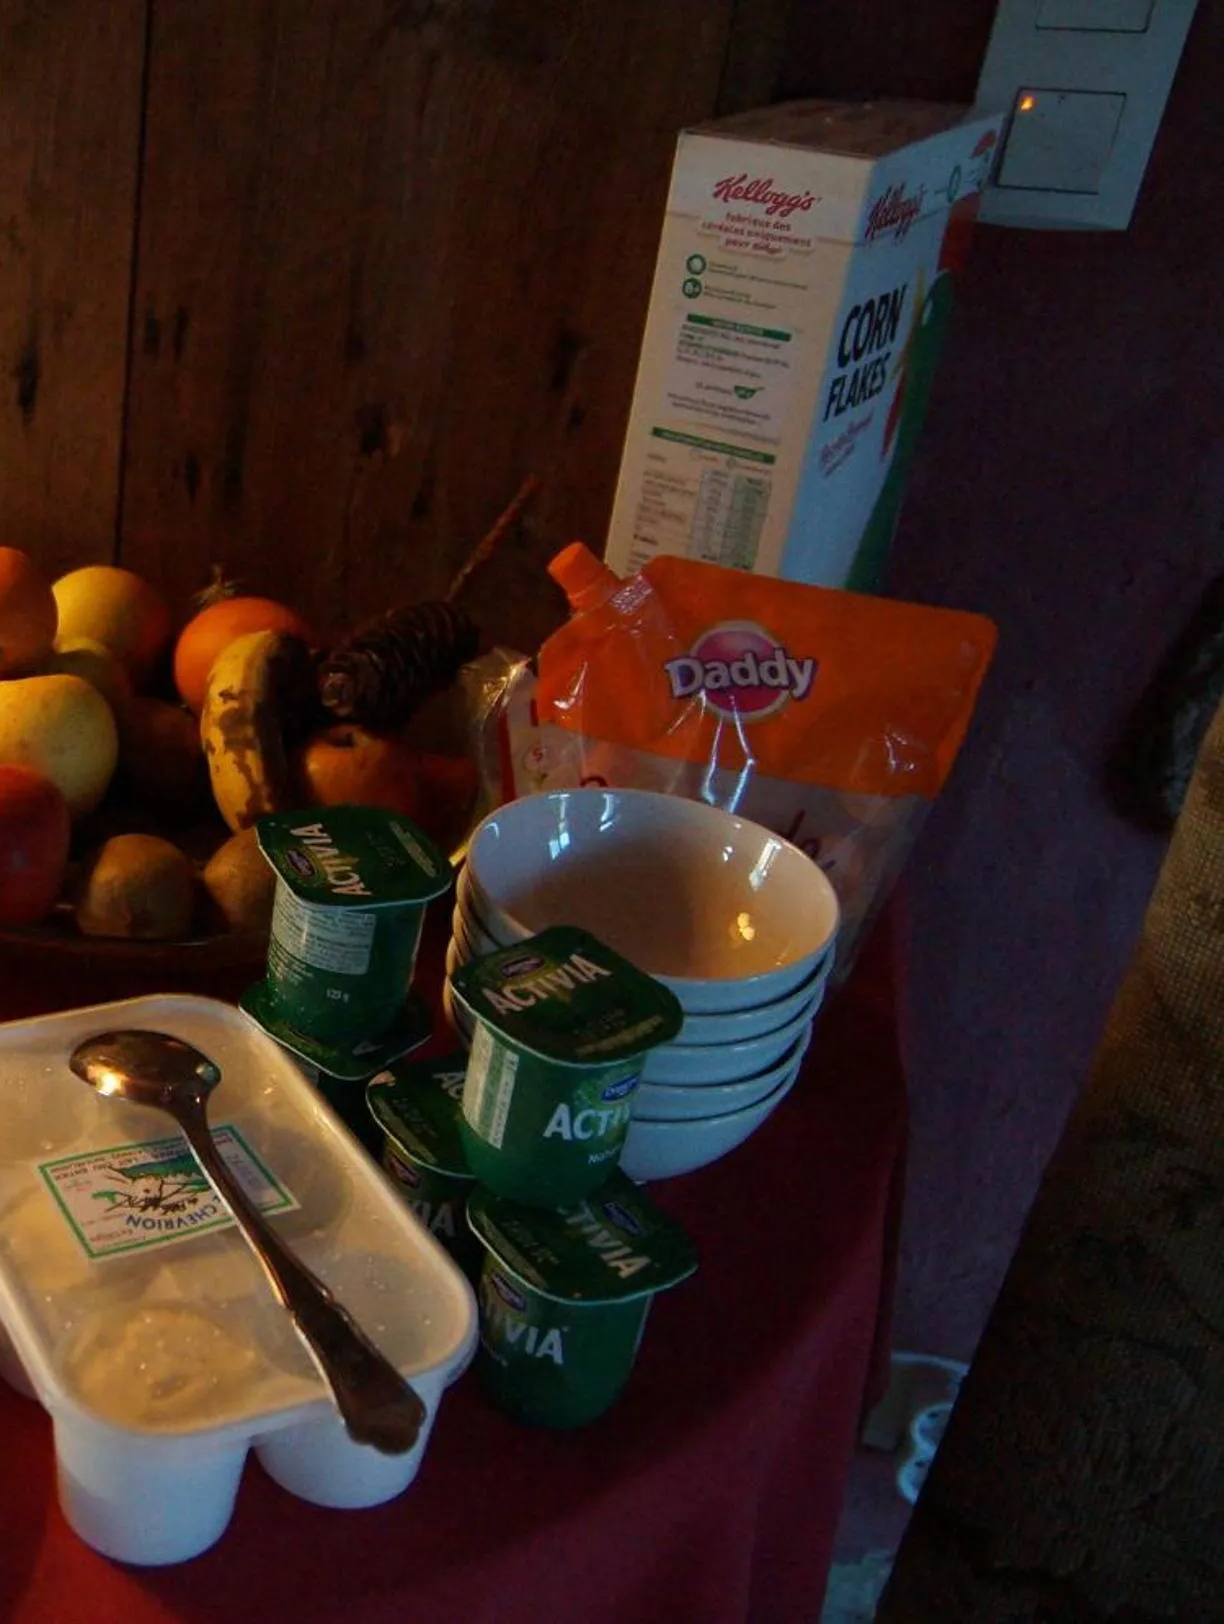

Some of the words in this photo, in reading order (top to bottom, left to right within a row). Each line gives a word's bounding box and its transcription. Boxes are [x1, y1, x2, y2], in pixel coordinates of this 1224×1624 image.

[713, 173, 816, 217] Kellogg's
[837, 283, 908, 368] CORN
[823, 352, 892, 422] FLAKES
[663, 647, 817, 700] Daddy
[288, 822, 374, 897] ACTIVIA
[481, 952, 613, 1016] ACTIVIA
[126, 1203, 218, 1230] CHEVRION
